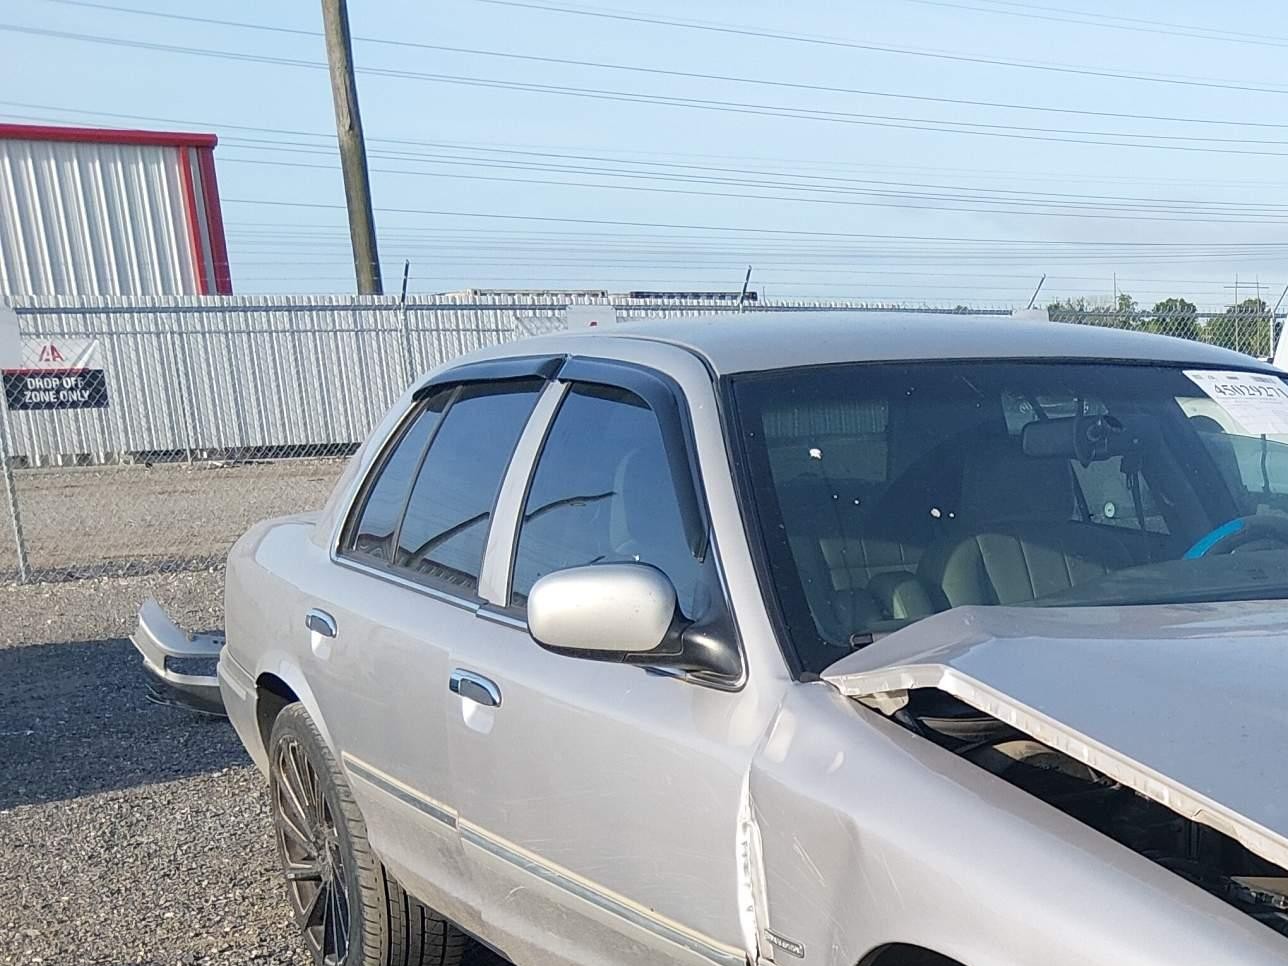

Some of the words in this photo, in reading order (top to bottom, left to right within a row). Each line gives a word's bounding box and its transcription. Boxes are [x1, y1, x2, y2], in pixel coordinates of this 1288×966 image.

[27, 377, 59, 389] DROP
[63, 376, 84, 388] OFF
[24, 391, 57, 403] ZONE
[61, 390, 90, 402] ONLY
